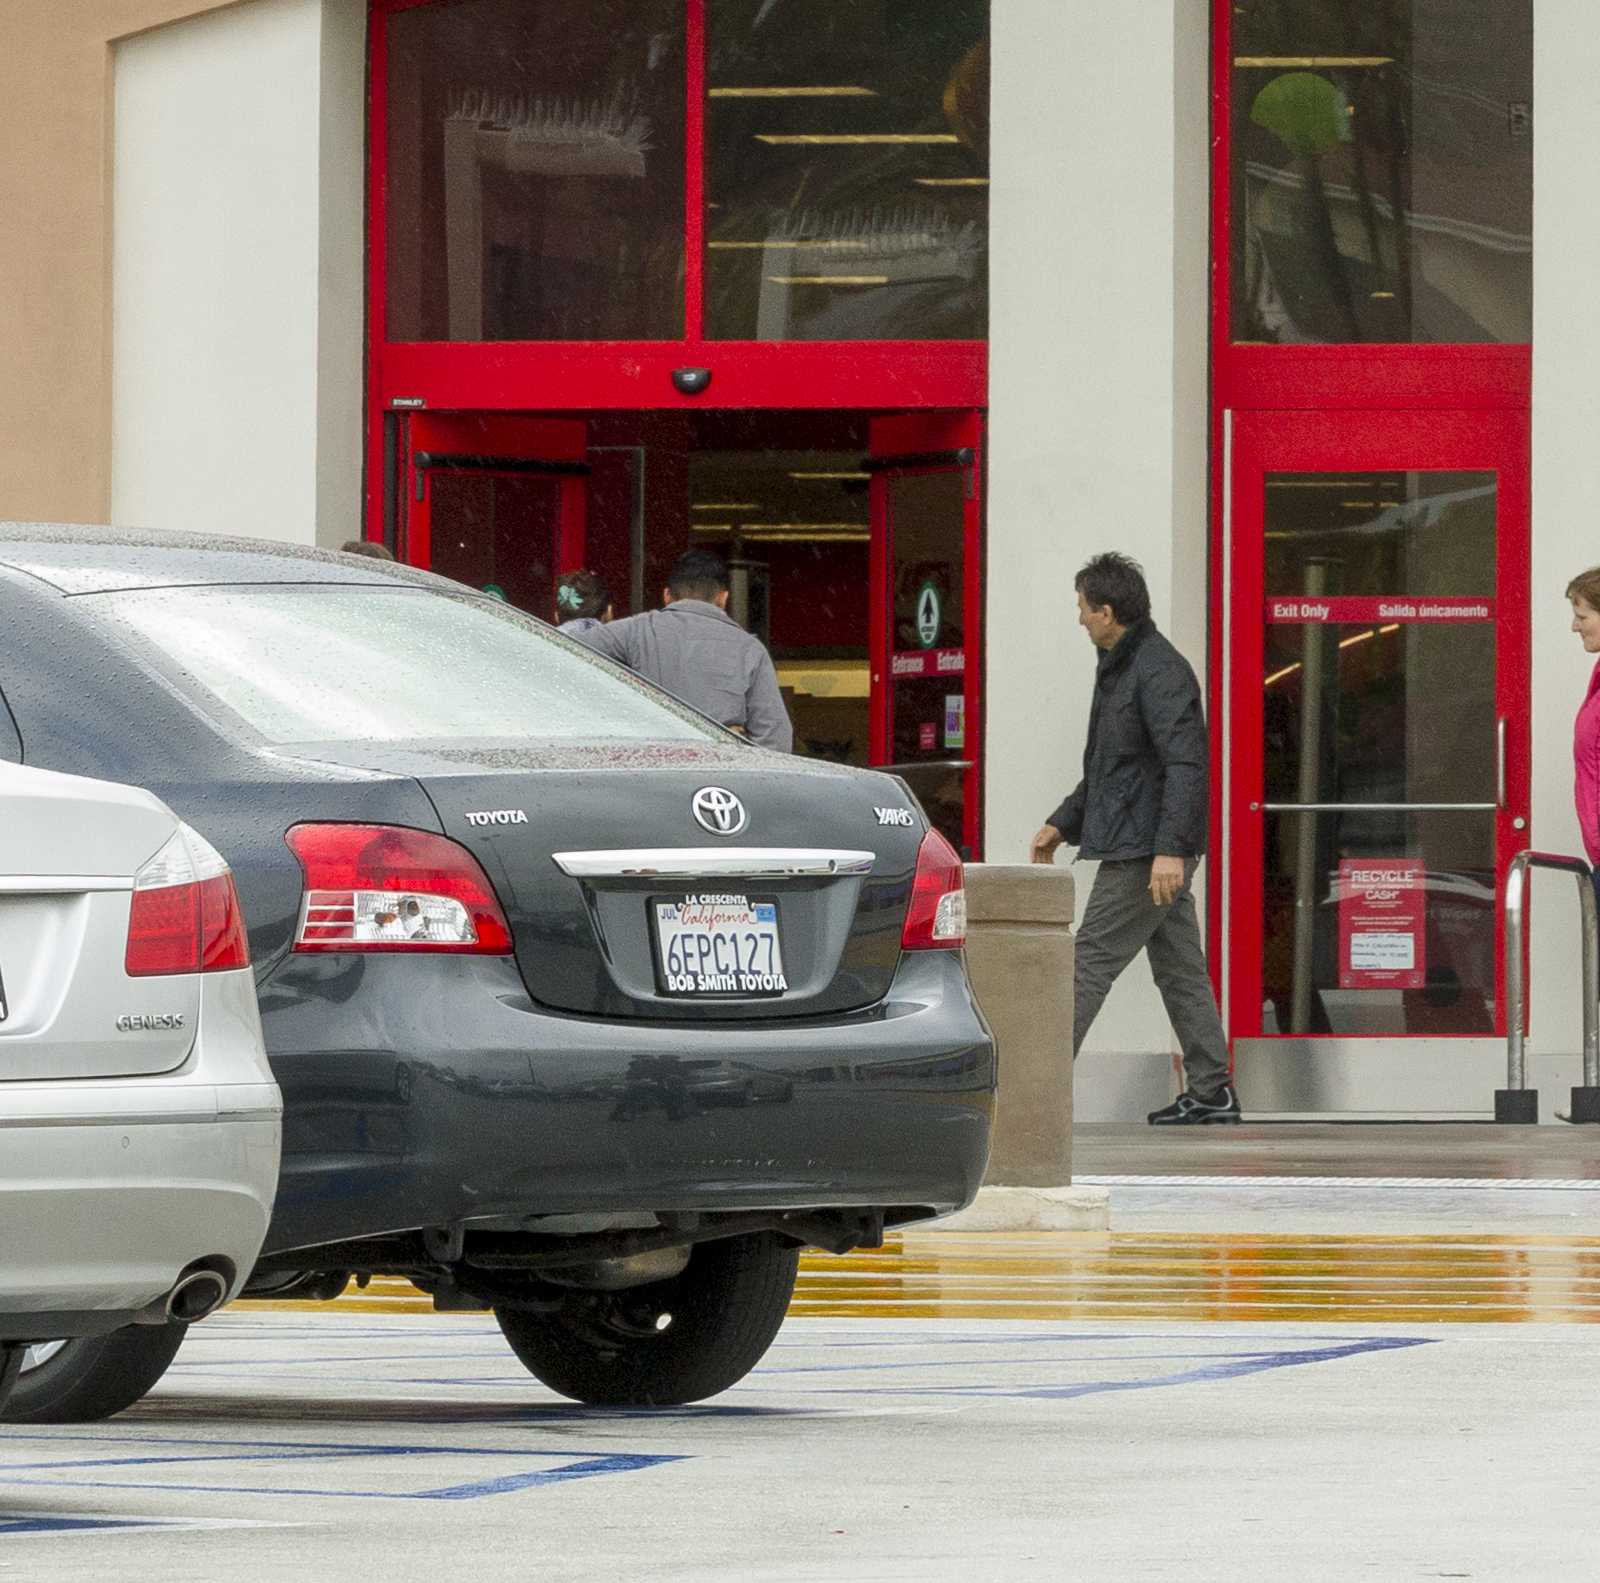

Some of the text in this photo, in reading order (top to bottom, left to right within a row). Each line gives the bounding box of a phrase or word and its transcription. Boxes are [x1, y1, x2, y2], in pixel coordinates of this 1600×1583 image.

[1273, 604, 1330, 620] Exit Only
[1378, 603, 1489, 617] Salida únicamente
[465, 810, 529, 826] TOYOTA
[1351, 870, 1414, 883] RECYCLE
[685, 894, 748, 905] LA CRESCENTA
[661, 907, 678, 920] JUL
[681, 904, 759, 932] California
[667, 932, 774, 976] 6EPC127
[667, 974, 788, 991] BOB SMITH TOYOTA
[116, 1014, 185, 1032] GENESIS
